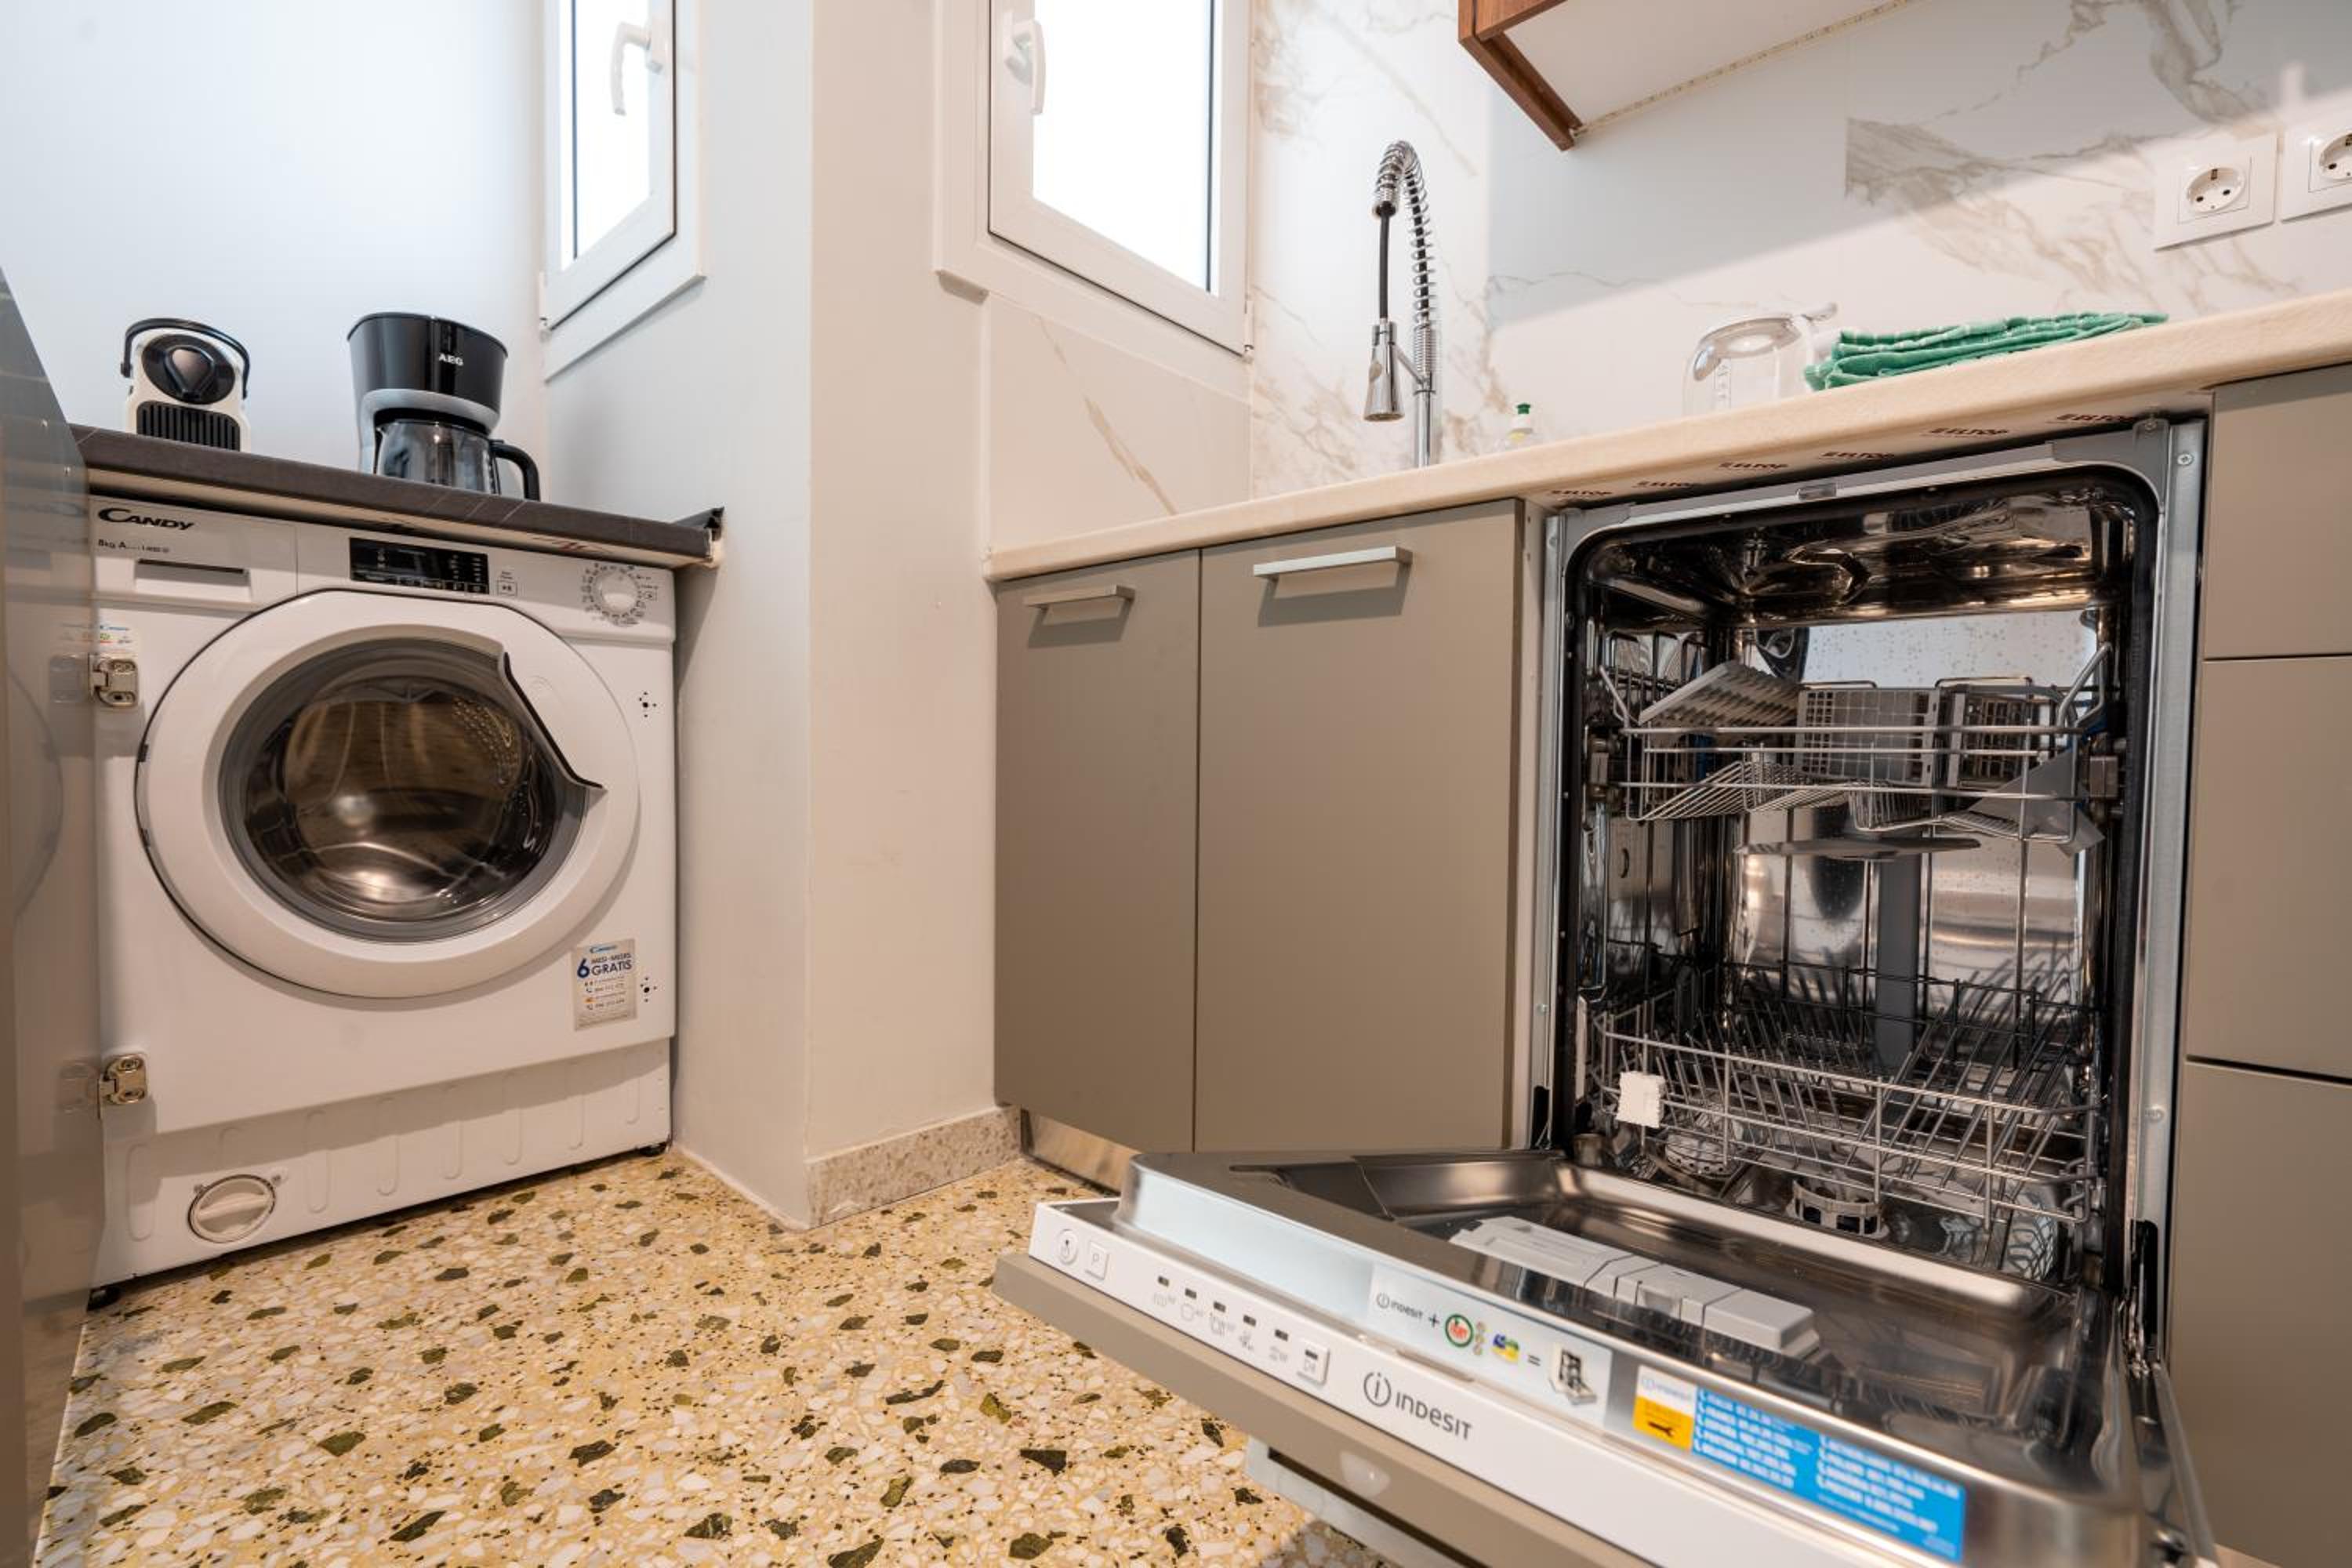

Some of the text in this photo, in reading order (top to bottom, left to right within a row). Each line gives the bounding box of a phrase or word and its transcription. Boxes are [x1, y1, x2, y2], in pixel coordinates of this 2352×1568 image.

[439, 352, 464, 366] AEG
[577, 958, 590, 978] 6
[591, 960, 632, 975] GRATIS
